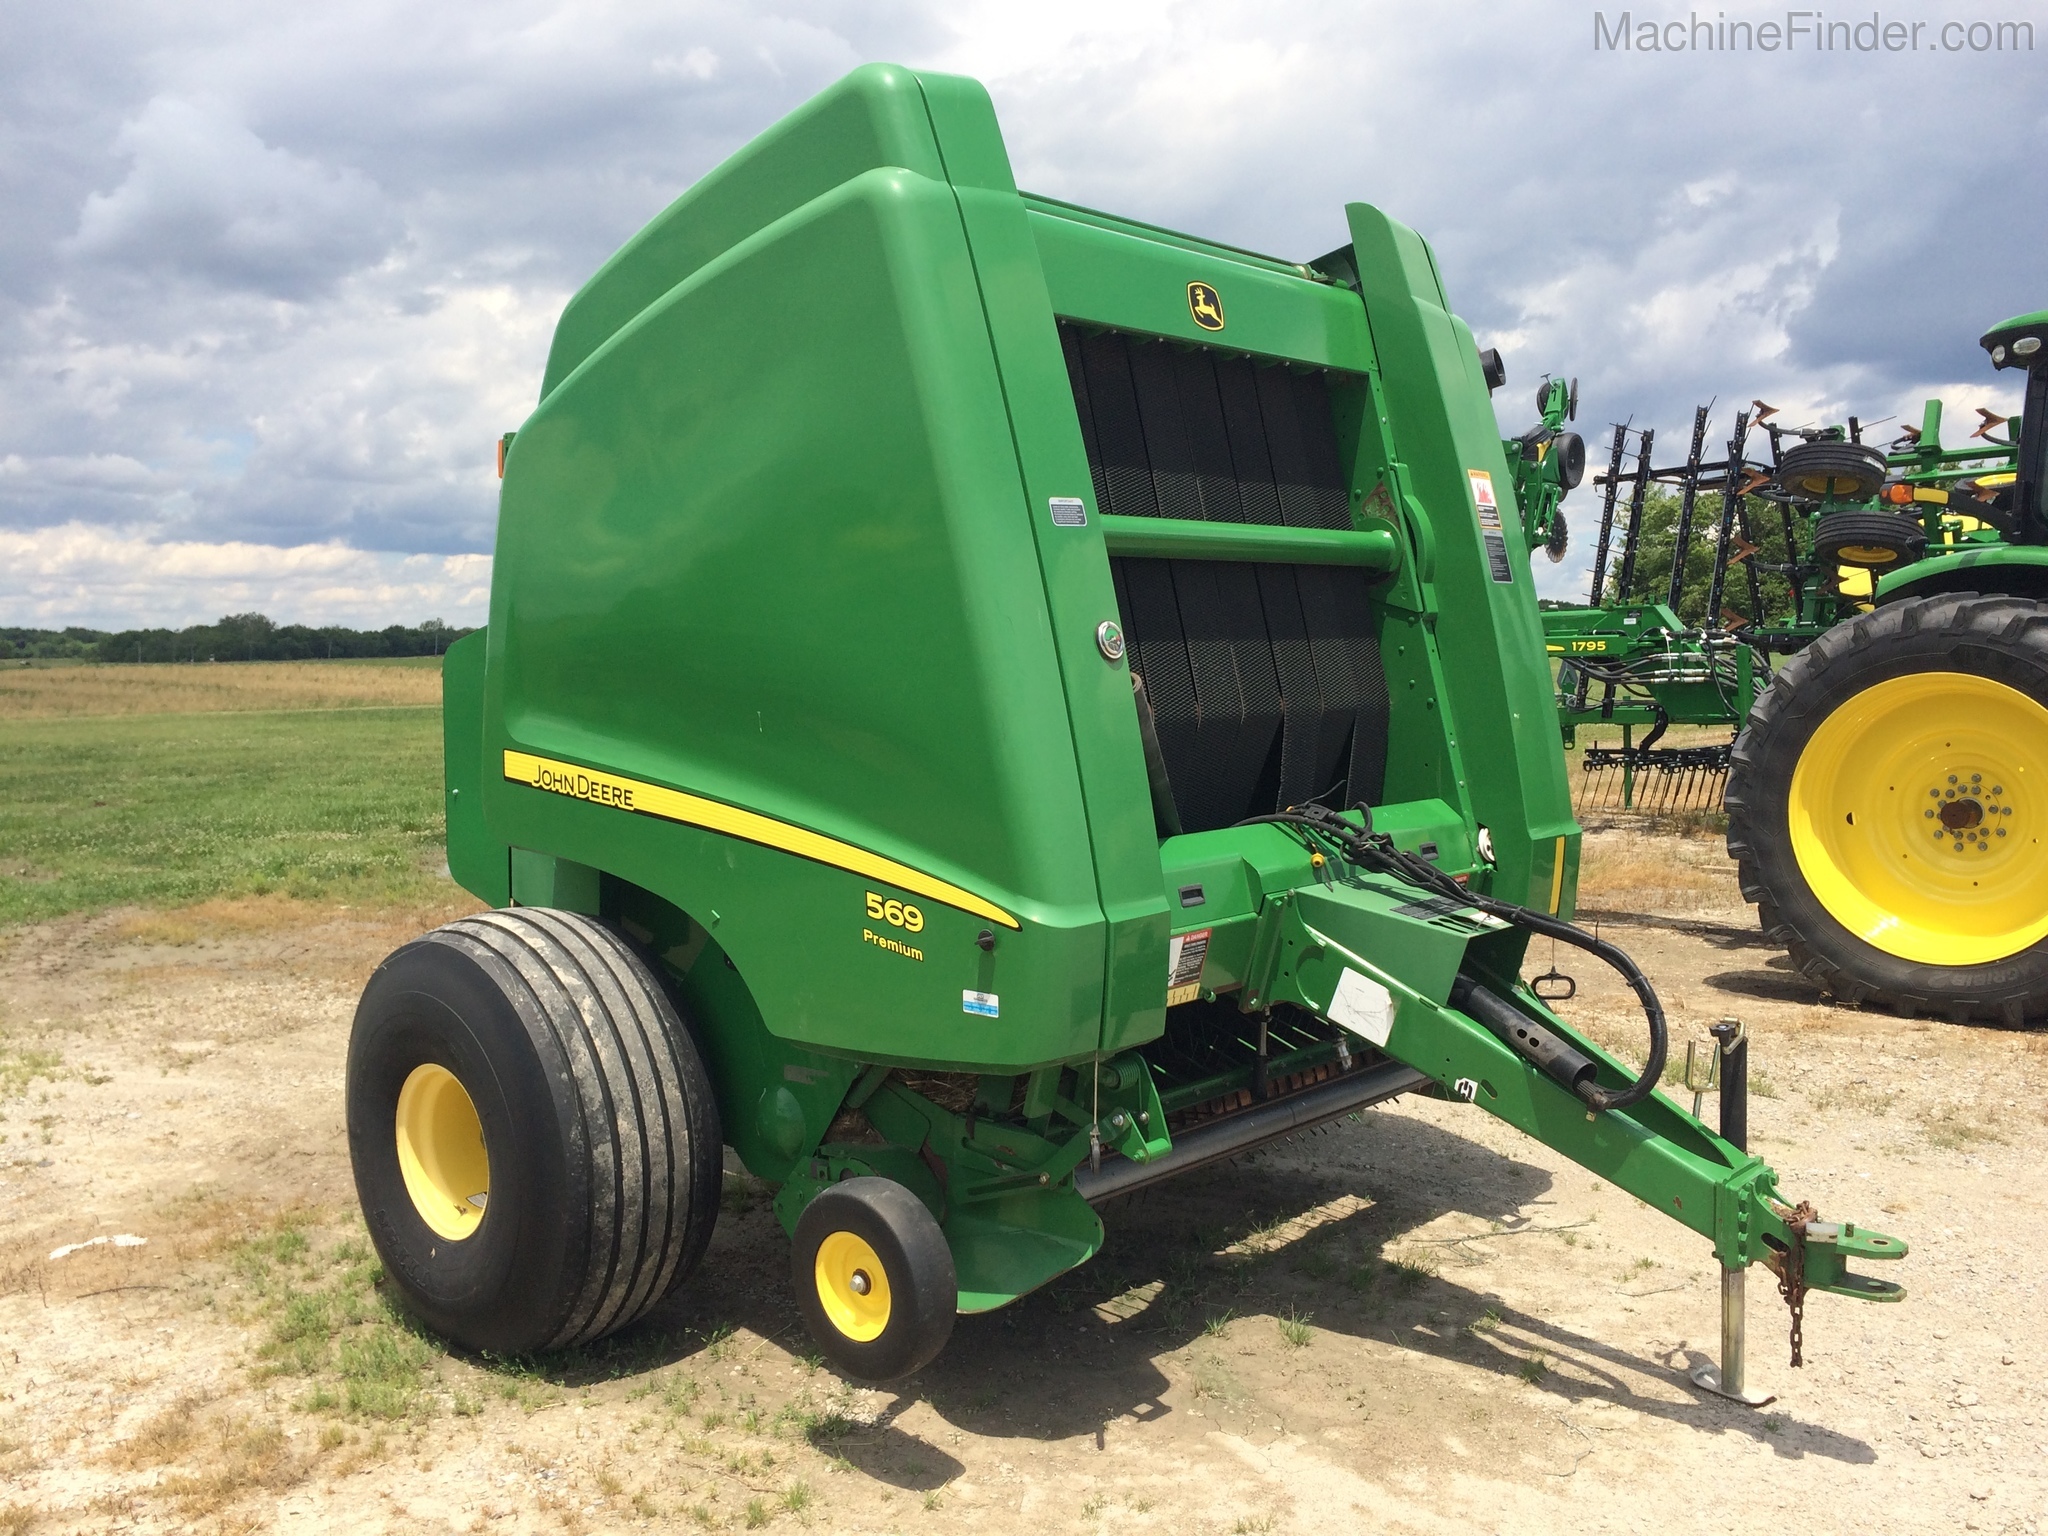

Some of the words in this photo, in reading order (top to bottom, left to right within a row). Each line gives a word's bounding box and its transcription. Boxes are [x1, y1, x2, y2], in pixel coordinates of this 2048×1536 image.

[1571, 640, 1606, 652] 1795
[533, 764, 575, 793] JOHN
[577, 773, 634, 807] DEERE
[865, 890, 925, 933] 569
[863, 928, 924, 962] Premium
